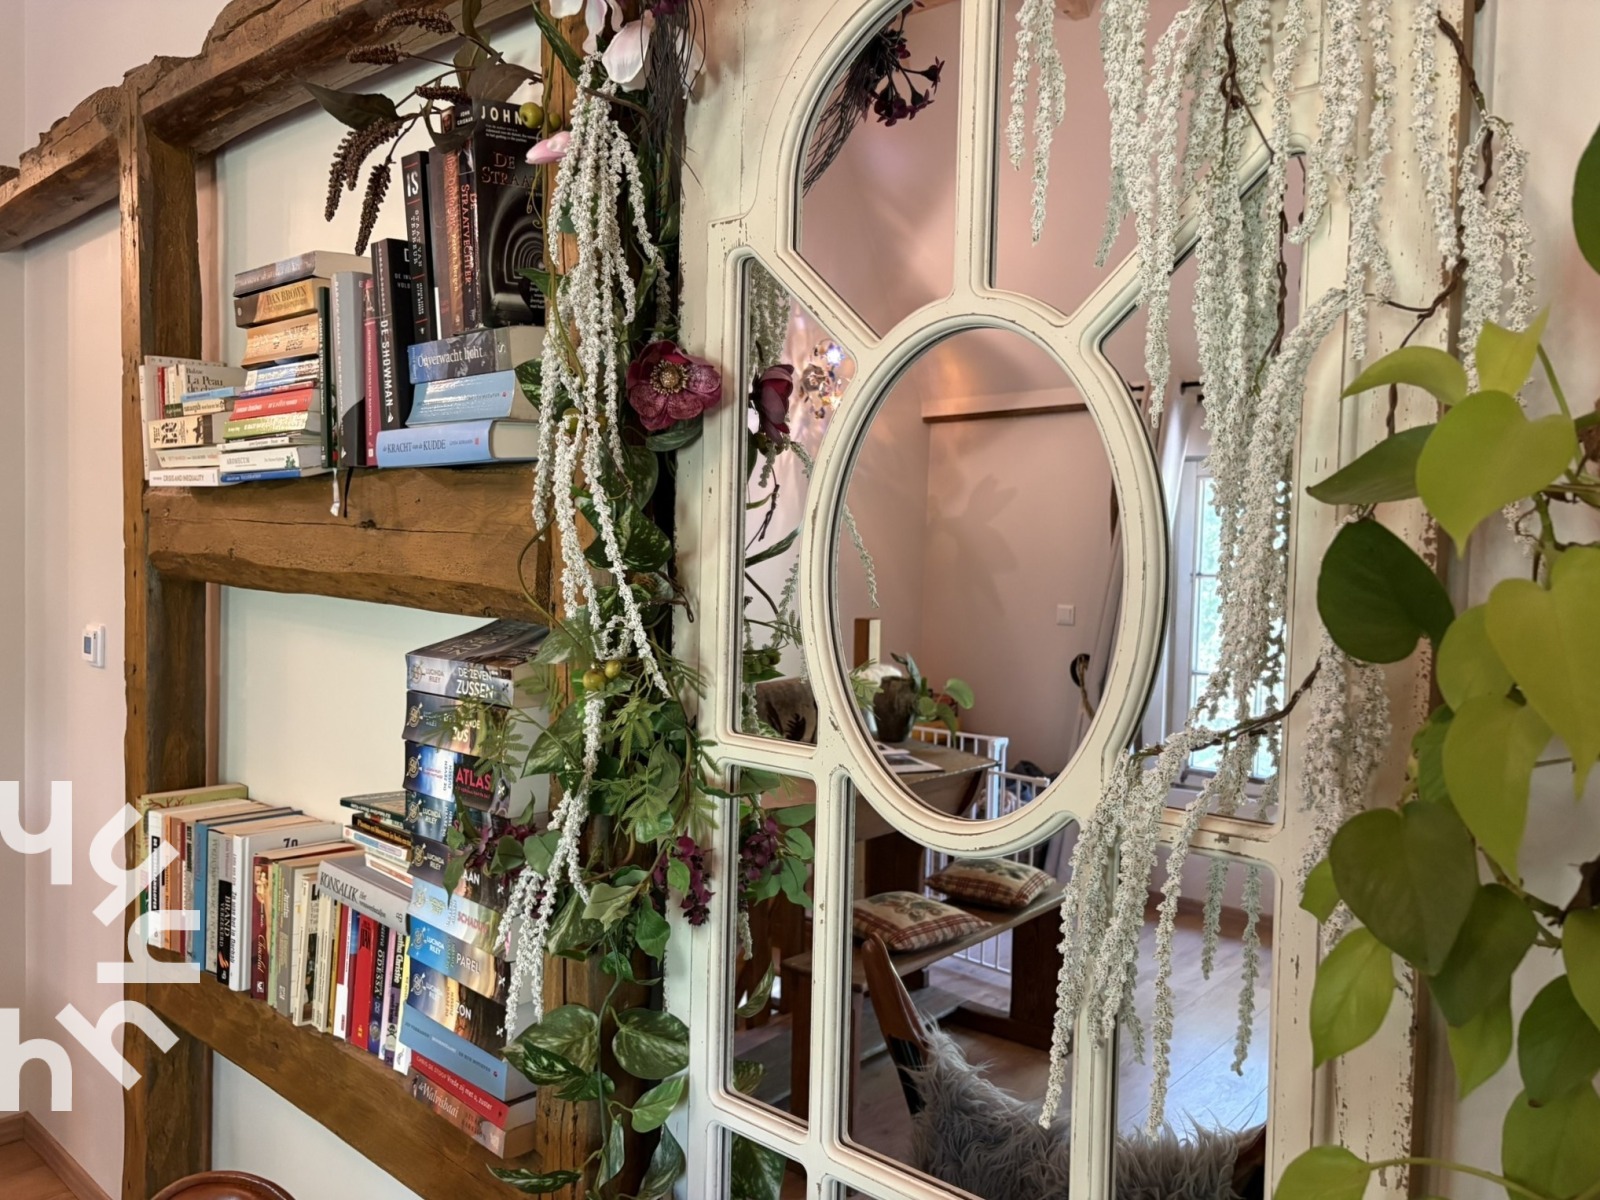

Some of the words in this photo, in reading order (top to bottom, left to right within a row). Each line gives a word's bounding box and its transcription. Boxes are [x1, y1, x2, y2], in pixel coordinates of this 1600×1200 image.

[494, 152, 516, 170] DE
[407, 171, 419, 197] IS
[462, 184, 472, 284] STRAATVECHTER
[266, 290, 280, 306] DAN
[280, 284, 307, 302] BROWN
[380, 320, 389, 336] DE
[187, 375, 200, 384] La
[202, 376, 224, 386] Peau
[382, 341, 393, 406] SHOWMAN
[388, 442, 412, 454] KRACHT
[424, 440, 446, 450] KUDDE
[458, 667, 469, 678] DE
[470, 668, 492, 681] ZEVEN
[456, 679, 494, 699] ZUSSEN
[456, 768, 492, 791] ATLAS
[422, 808, 442, 818] LUCINDA
[426, 853, 444, 865] LUCINDA
[430, 862, 442, 870] RILEY
[463, 869, 480, 886] AAN
[320, 872, 360, 904] KONSALIK
[426, 935, 444, 950] LUCINDA
[430, 944, 442, 955] RILEY
[257, 934, 266, 972] Chocolat
[456, 952, 480, 974] PAREL
[374, 950, 382, 994] ODESSA
[394, 954, 403, 984] Christie
[456, 1001, 472, 1020] ZON
[423, 1082, 460, 1118] Walvisbaai
[446, 1074, 460, 1090] Vrede
[477, 1097, 493, 1111] zuster
